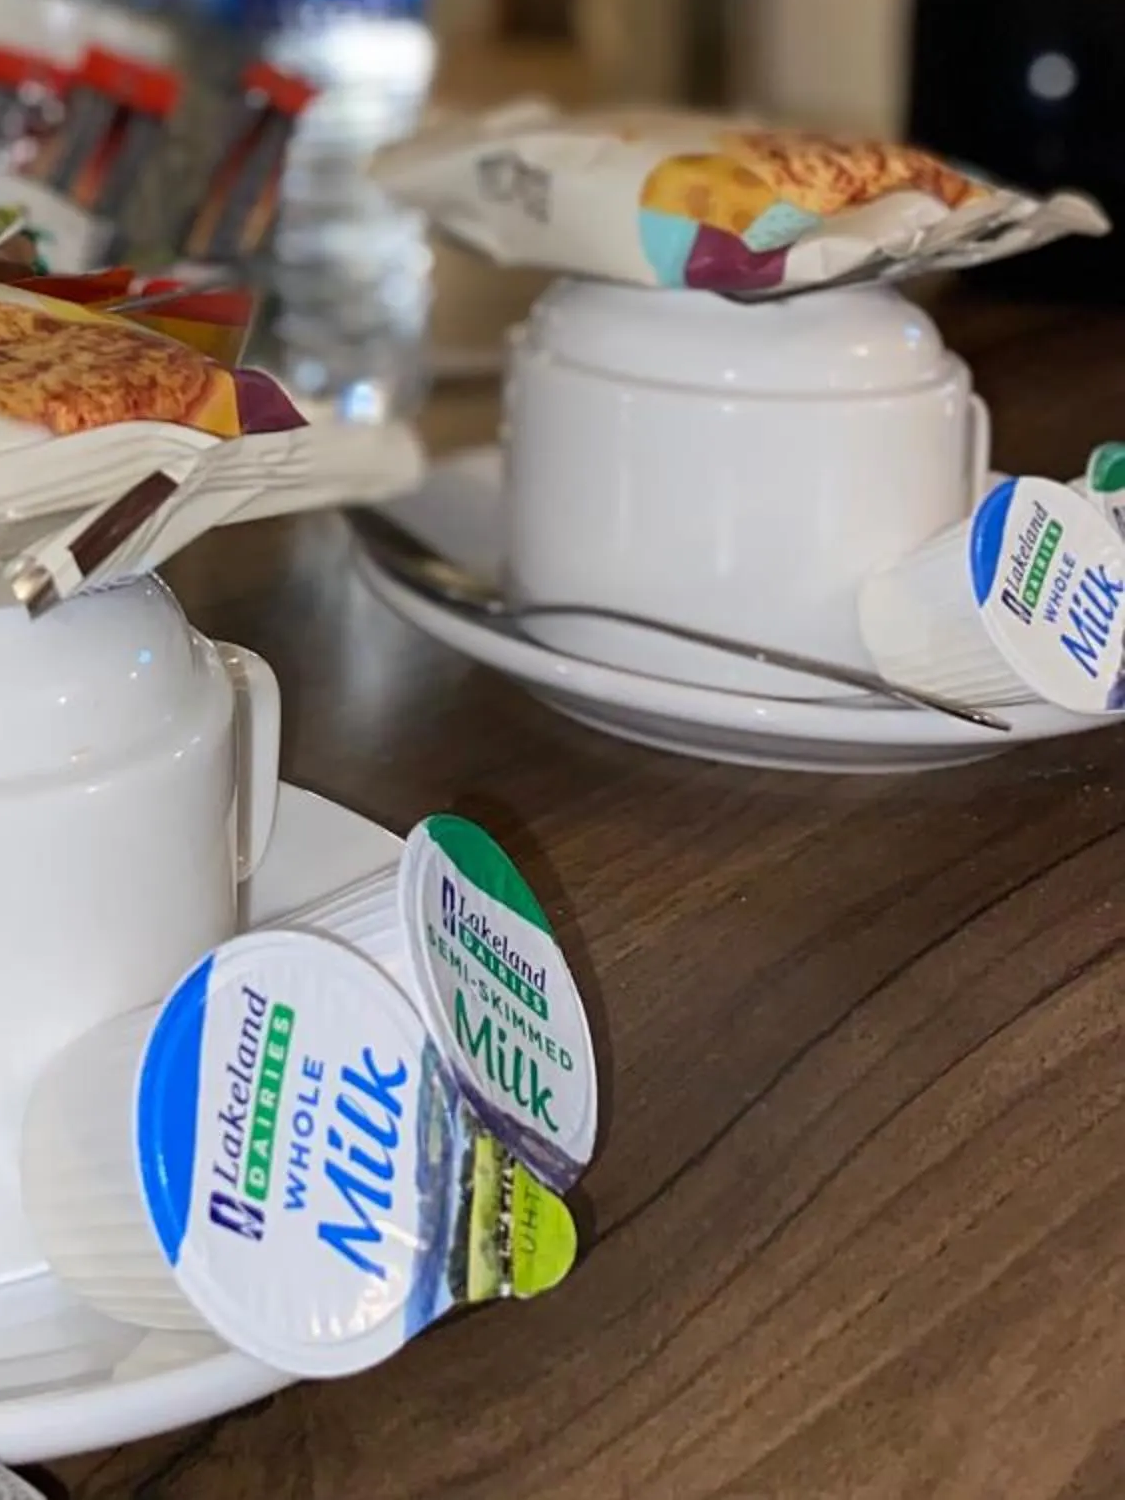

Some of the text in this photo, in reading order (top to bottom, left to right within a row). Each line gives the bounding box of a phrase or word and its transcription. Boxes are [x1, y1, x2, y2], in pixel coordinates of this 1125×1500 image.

[1004, 500, 1049, 594] Lakeland
[1043, 552, 1076, 623] WHOLE
[1060, 564, 1124, 678] Milk
[427, 923, 573, 1072] SEMI-SKIMMED
[458, 896, 547, 992] Lakeland
[458, 924, 549, 1020] DAIRIES
[213, 985, 269, 1189] Lakeland
[245, 1012, 292, 1192] DAIRIES
[454, 987, 559, 1132] Milk
[284, 1054, 325, 1210] WHOLE
[317, 1046, 408, 1280] Milk
[518, 1185, 541, 1254] UHT
